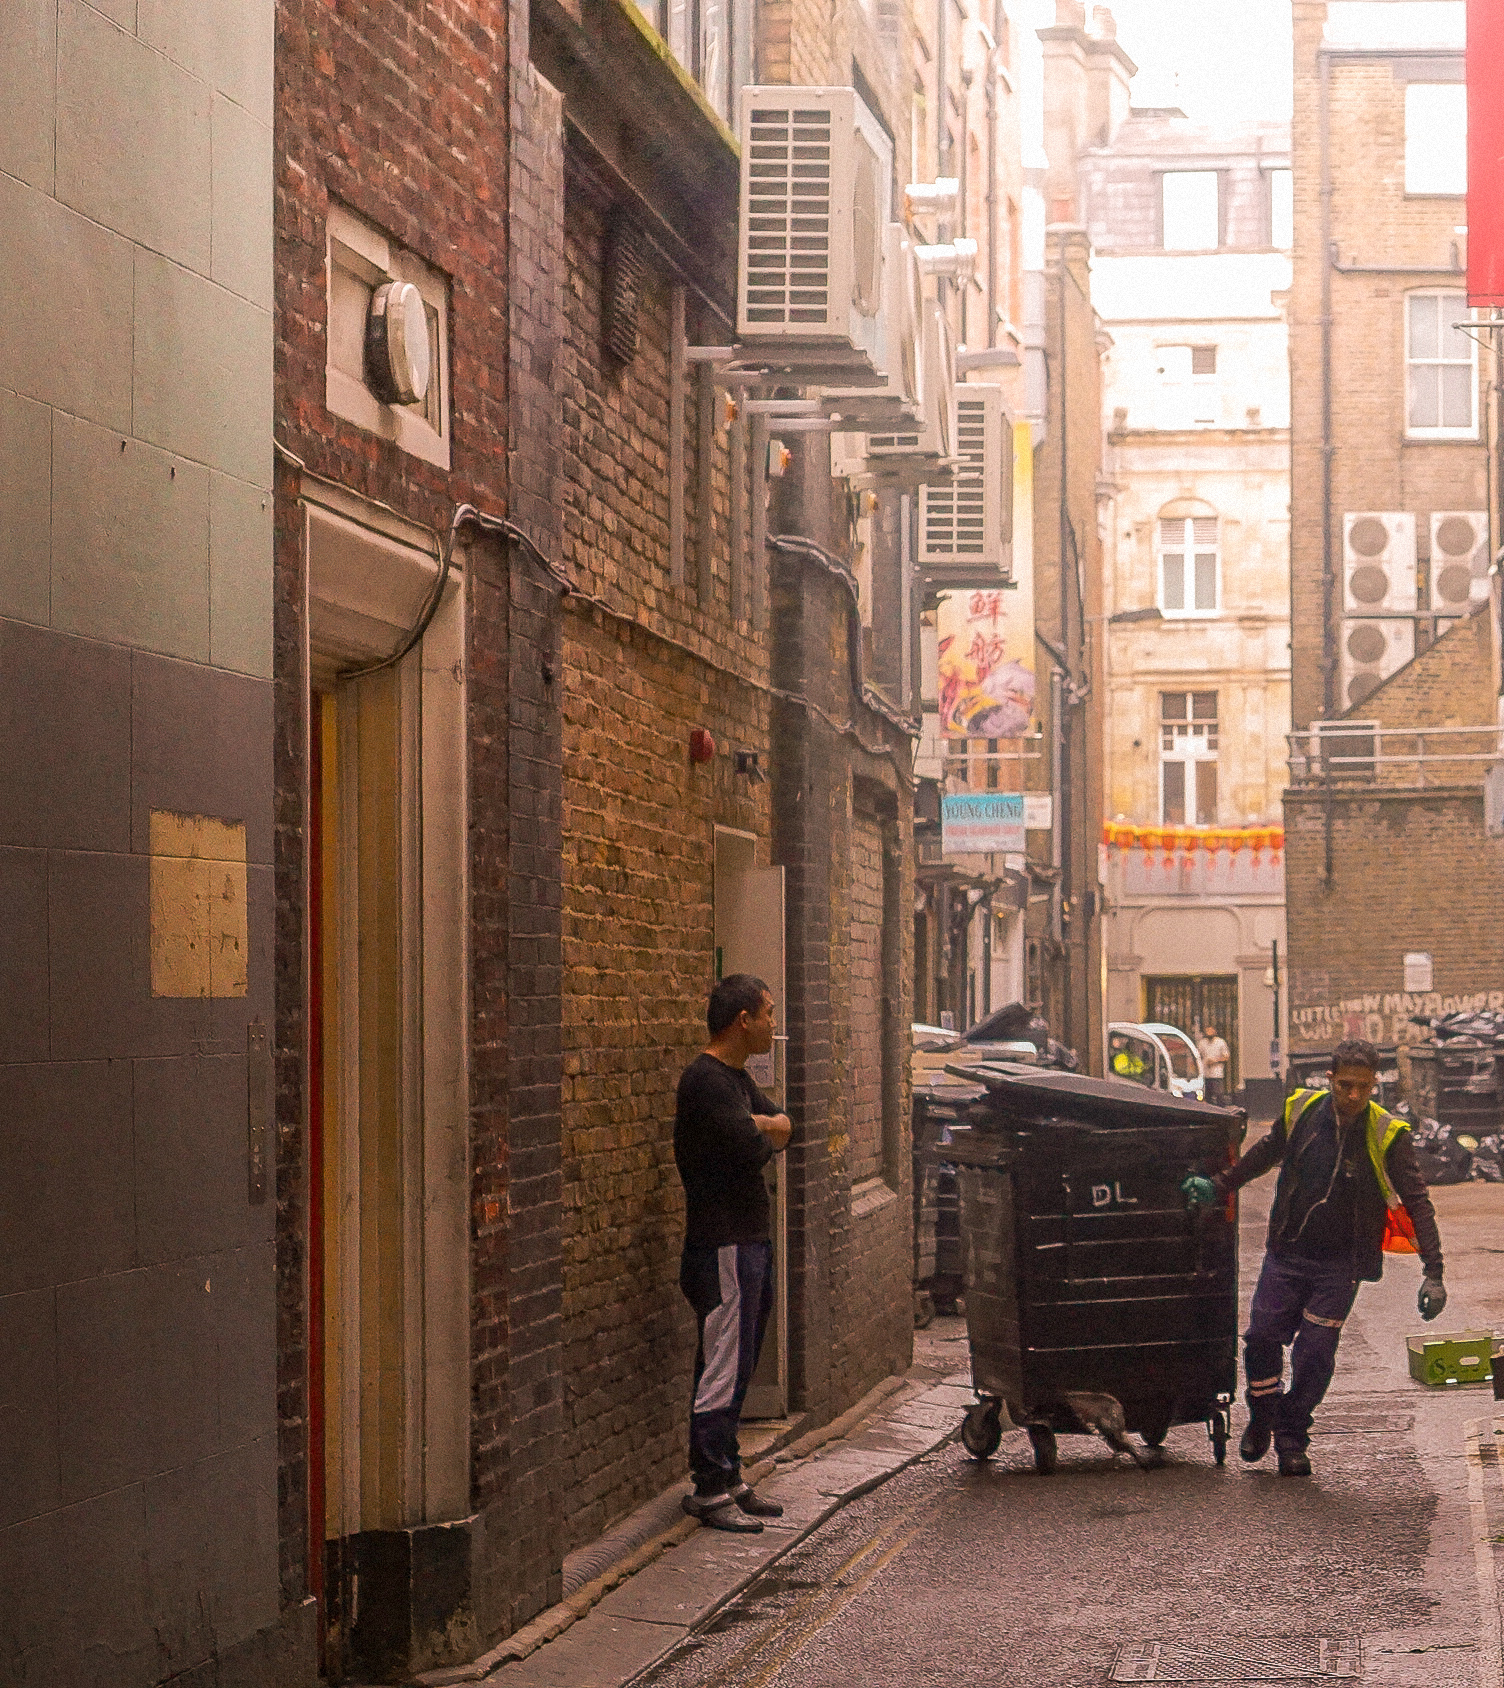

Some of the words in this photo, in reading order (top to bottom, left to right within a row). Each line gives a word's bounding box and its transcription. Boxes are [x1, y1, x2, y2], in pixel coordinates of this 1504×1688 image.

[945, 801, 982, 819] YOUNG
[984, 801, 1022, 818] CHENG
[1292, 1006, 1341, 1024] LITTLE
[1091, 1181, 1138, 1207] DL
